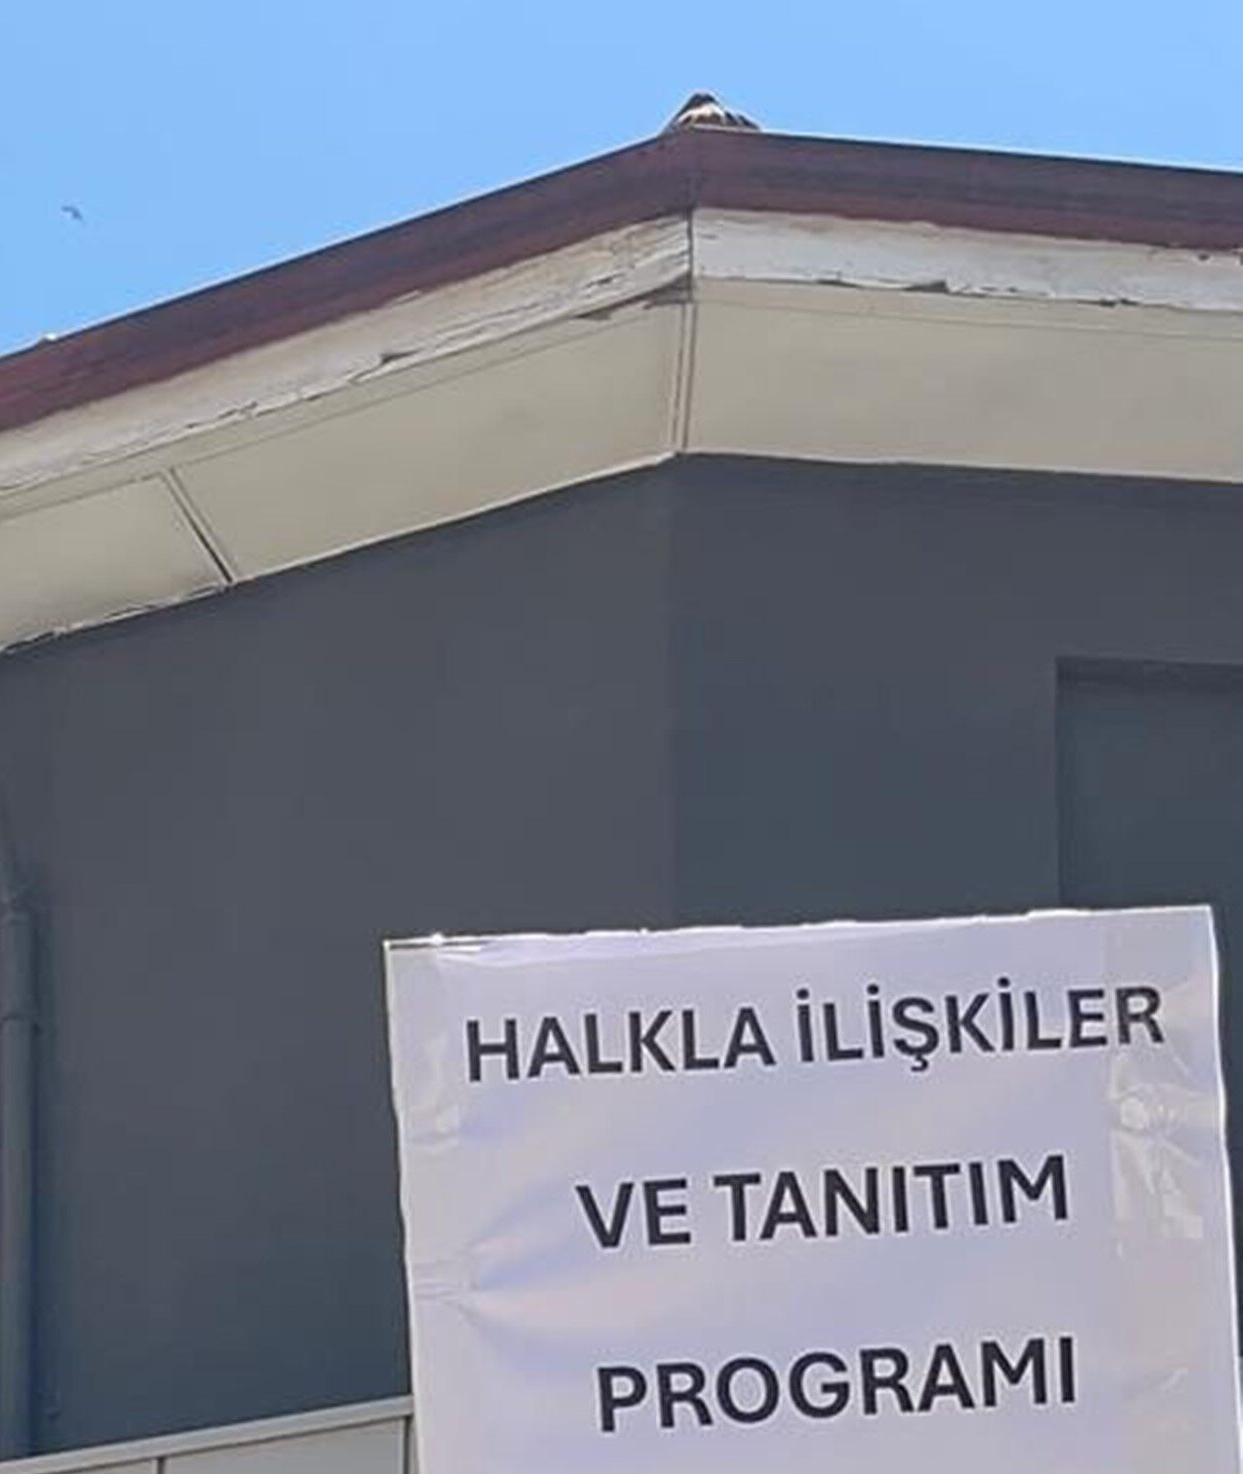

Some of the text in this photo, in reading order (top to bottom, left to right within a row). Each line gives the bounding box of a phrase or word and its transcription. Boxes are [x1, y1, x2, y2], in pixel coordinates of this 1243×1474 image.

[466, 976, 1166, 1083] HALKLA İLİŞKİLER
[576, 1154, 1069, 1248] VE TANITIM
[596, 1336, 1077, 1433] PROGRAMI
